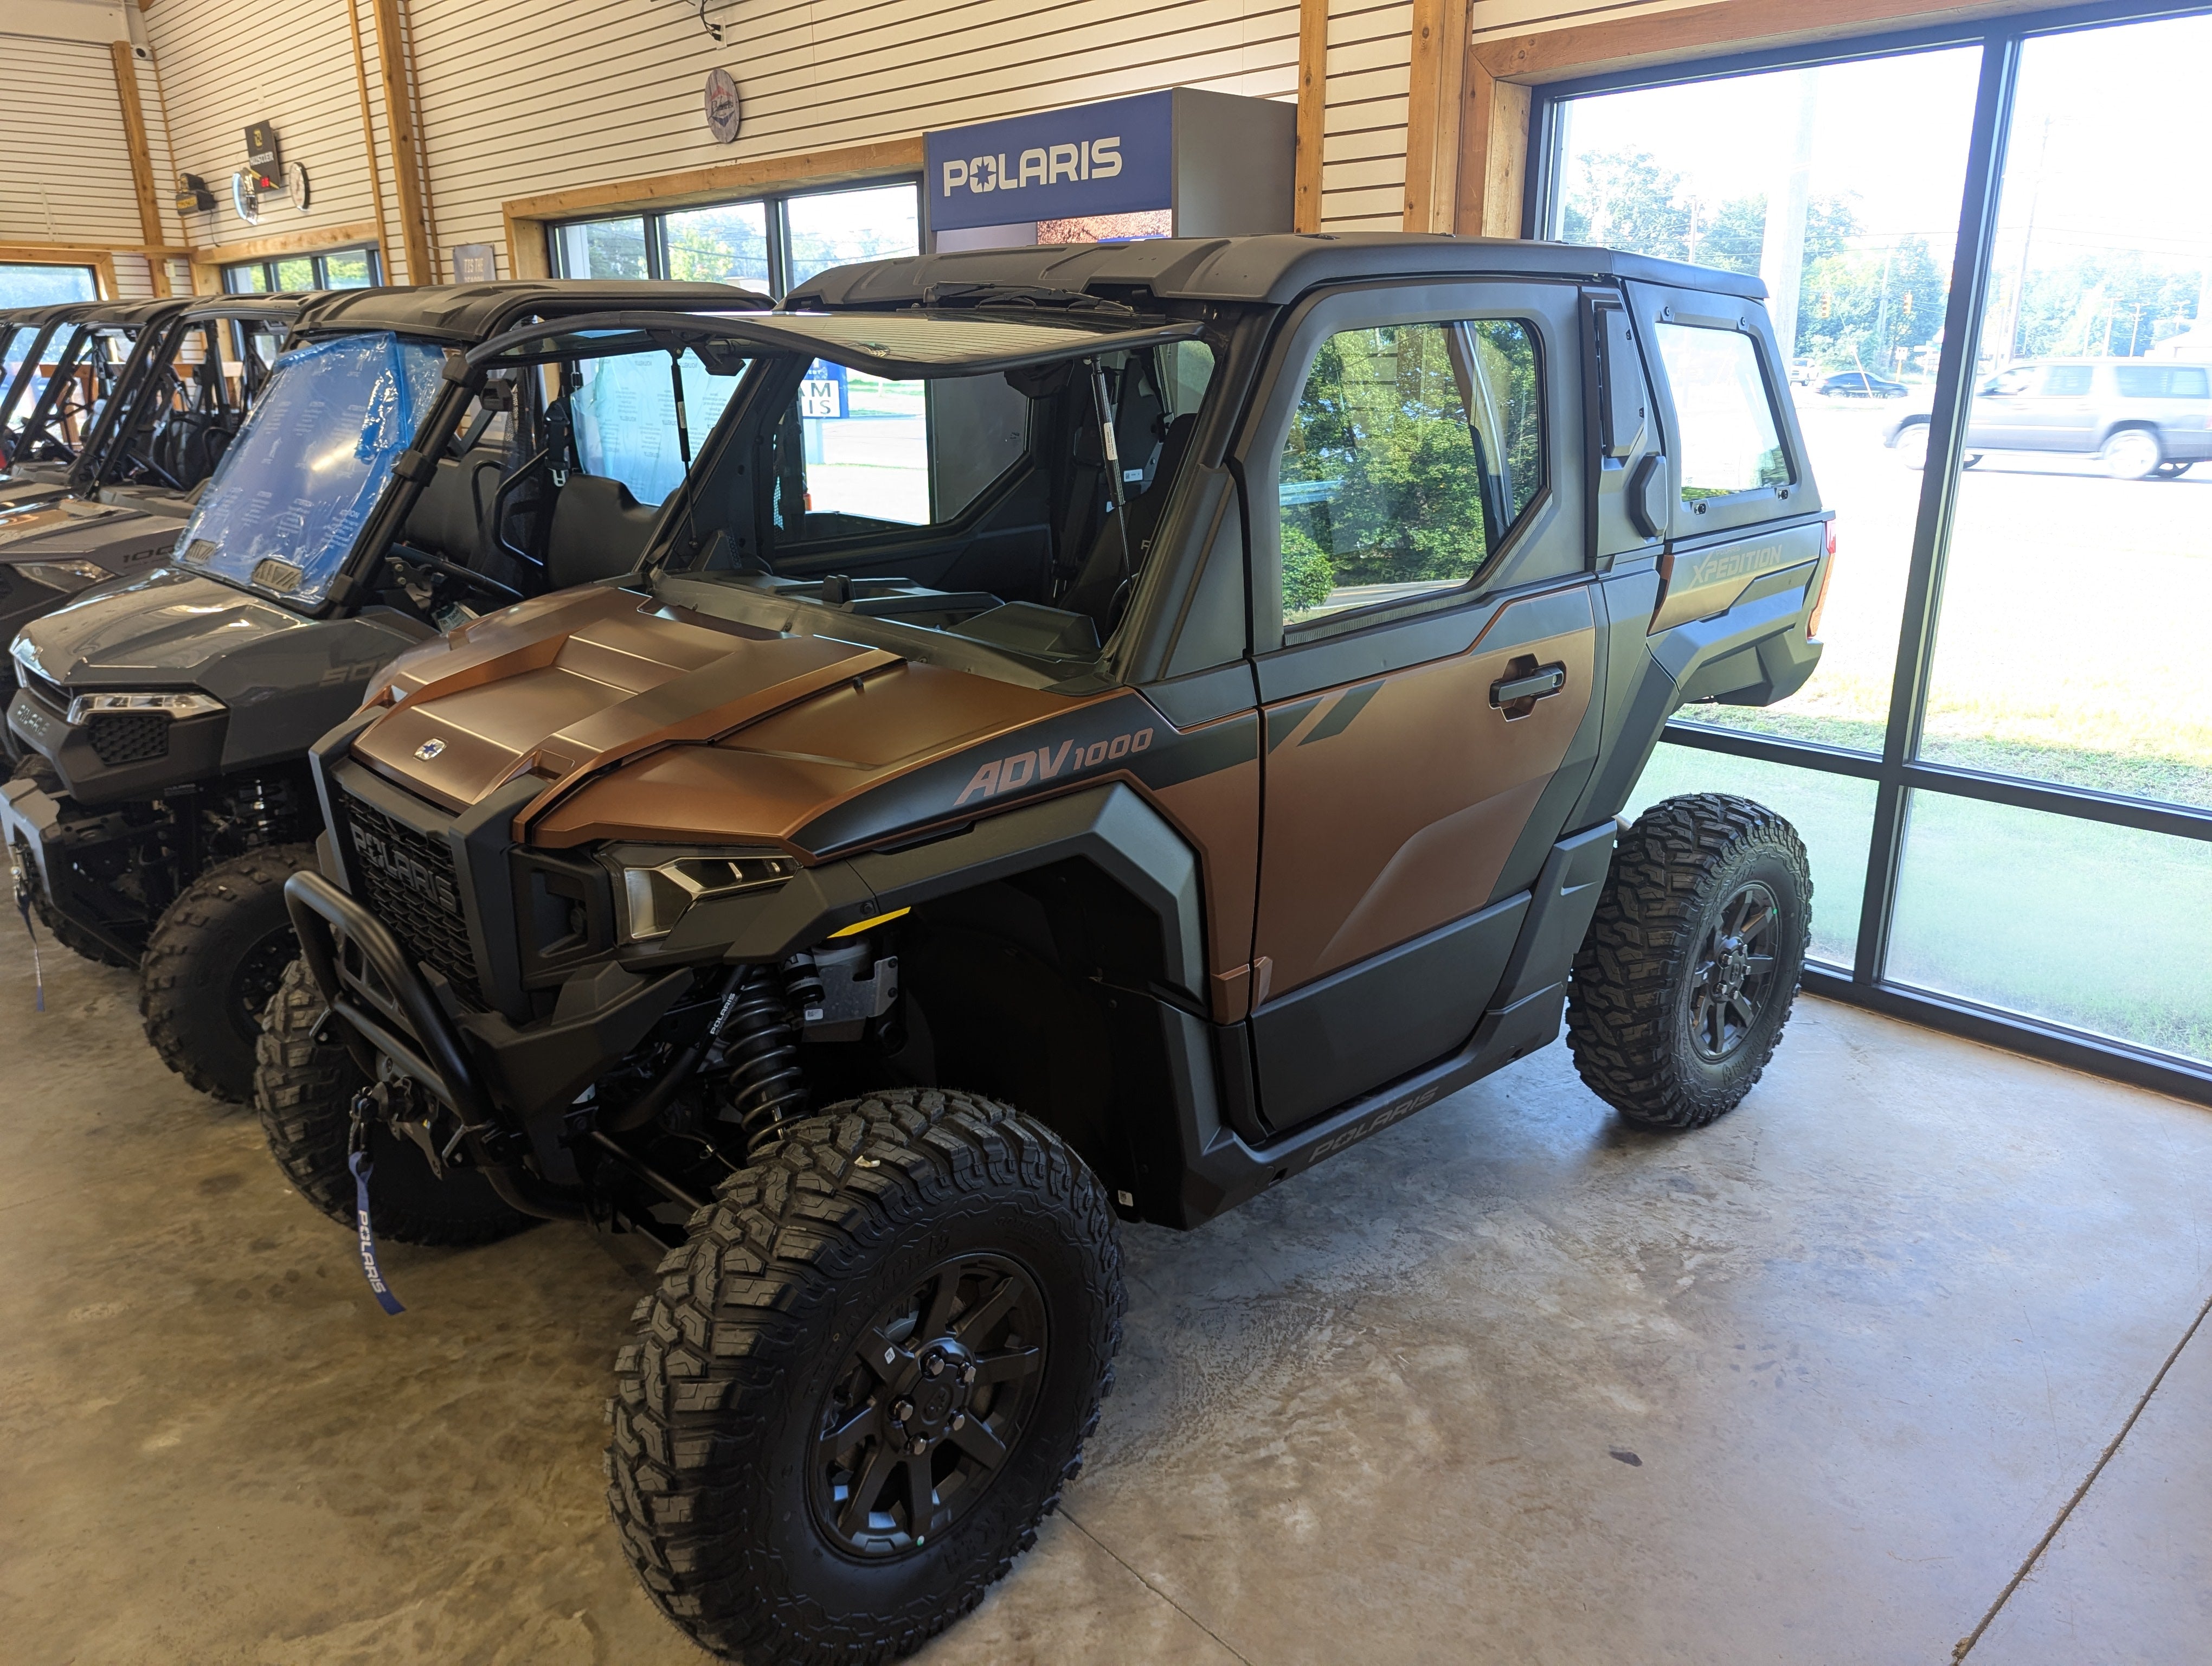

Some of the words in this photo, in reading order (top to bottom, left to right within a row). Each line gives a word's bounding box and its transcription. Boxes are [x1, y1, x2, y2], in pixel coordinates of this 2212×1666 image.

[249, 151, 274, 166] HUSTLER
[943, 136, 1122, 197] POLARIS
[1688, 544, 1783, 590] XPEDITION
[1716, 545, 1741, 556] POLARIS
[17, 704, 50, 736] POLARIS
[954, 739, 1075, 806] ADV
[1073, 727, 1154, 771] 1000
[350, 821, 458, 913] POLARIS
[709, 992, 736, 1035] POLARIS
[1308, 1086, 1439, 1163] POLARIS
[358, 1210, 387, 1293] POLARIS
